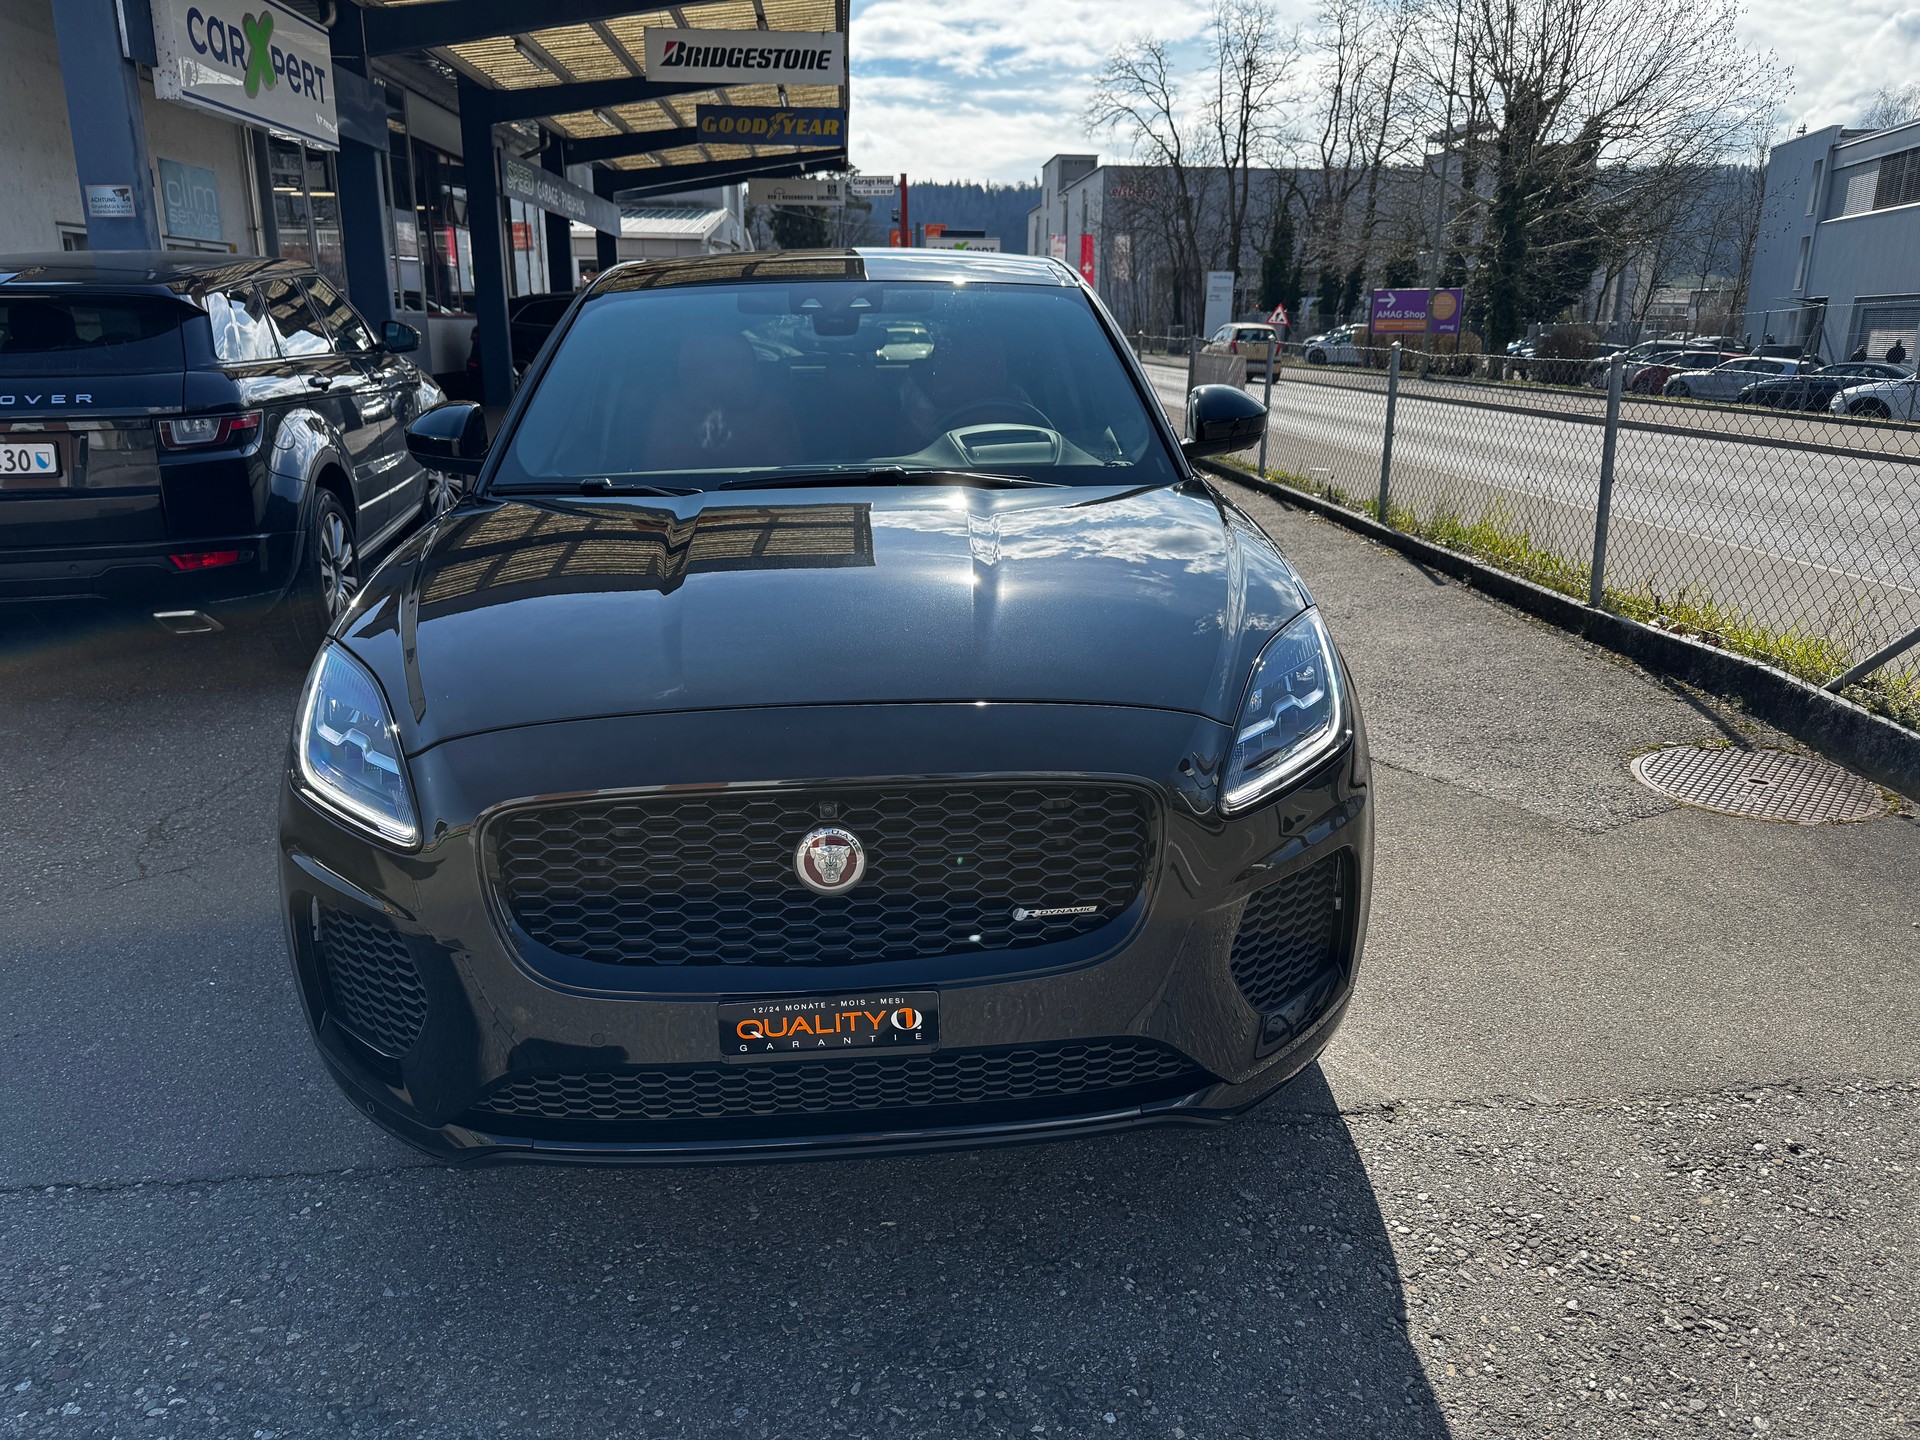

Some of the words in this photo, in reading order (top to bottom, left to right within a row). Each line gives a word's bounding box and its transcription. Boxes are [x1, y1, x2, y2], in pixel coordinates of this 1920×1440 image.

[660, 41, 832, 71] BRIDGESTONE
[166, 173, 217, 214] clim
[507, 160, 535, 196] SPEED
[537, 181, 559, 206] GARAGE
[169, 209, 219, 228] service
[1376, 310, 1402, 319] AMAG
[1404, 310, 1426, 320] Shop
[752, 1005, 780, 1014] 12/24
[785, 1001, 826, 1012] MONATE
[840, 998, 866, 1007] MOIS
[880, 997, 905, 1005] MESI
[736, 1009, 887, 1040] QUALITY
[739, 1032, 922, 1052] GARANTIE
